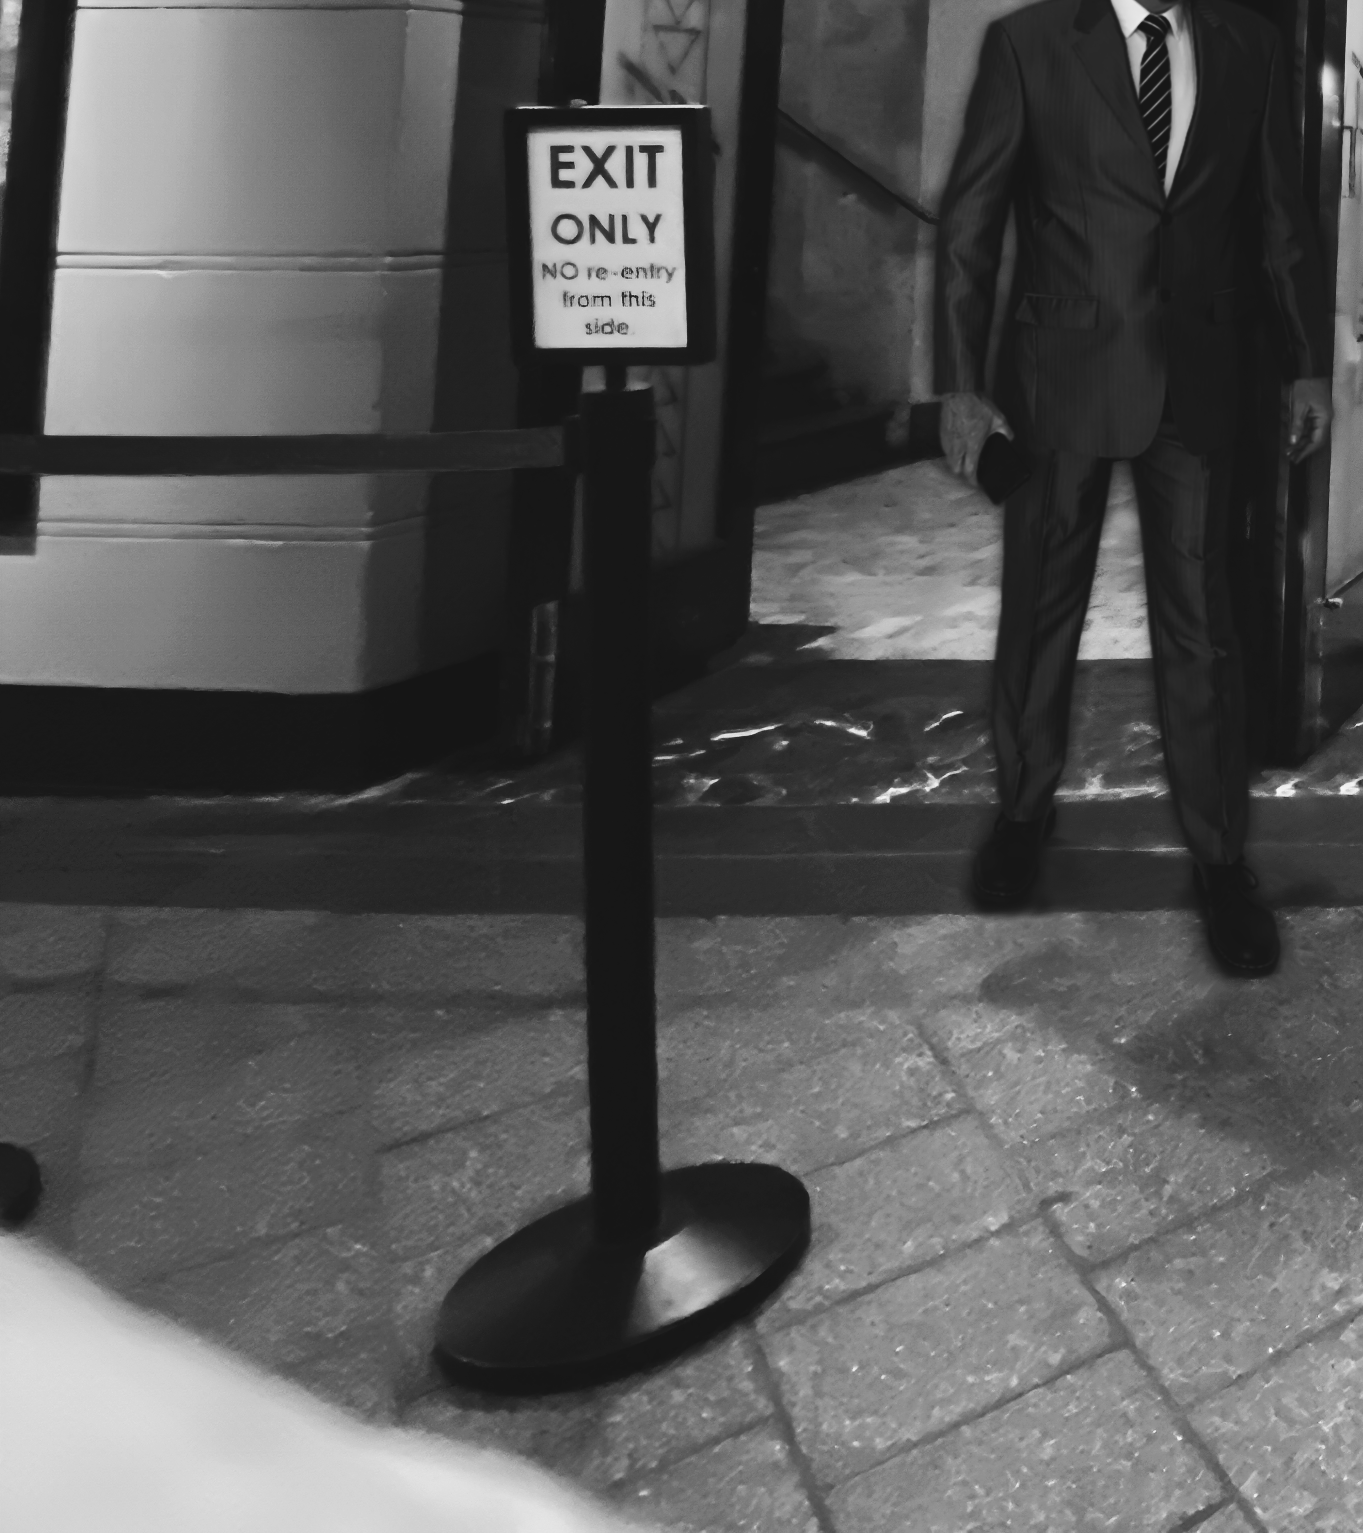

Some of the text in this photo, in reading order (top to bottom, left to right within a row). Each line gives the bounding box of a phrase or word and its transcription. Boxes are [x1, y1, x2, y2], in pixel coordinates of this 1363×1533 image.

[549, 144, 665, 190] EXIT
[550, 212, 663, 245] ONLY
[541, 262, 677, 284] NO re-entry
[562, 290, 657, 308] from this
